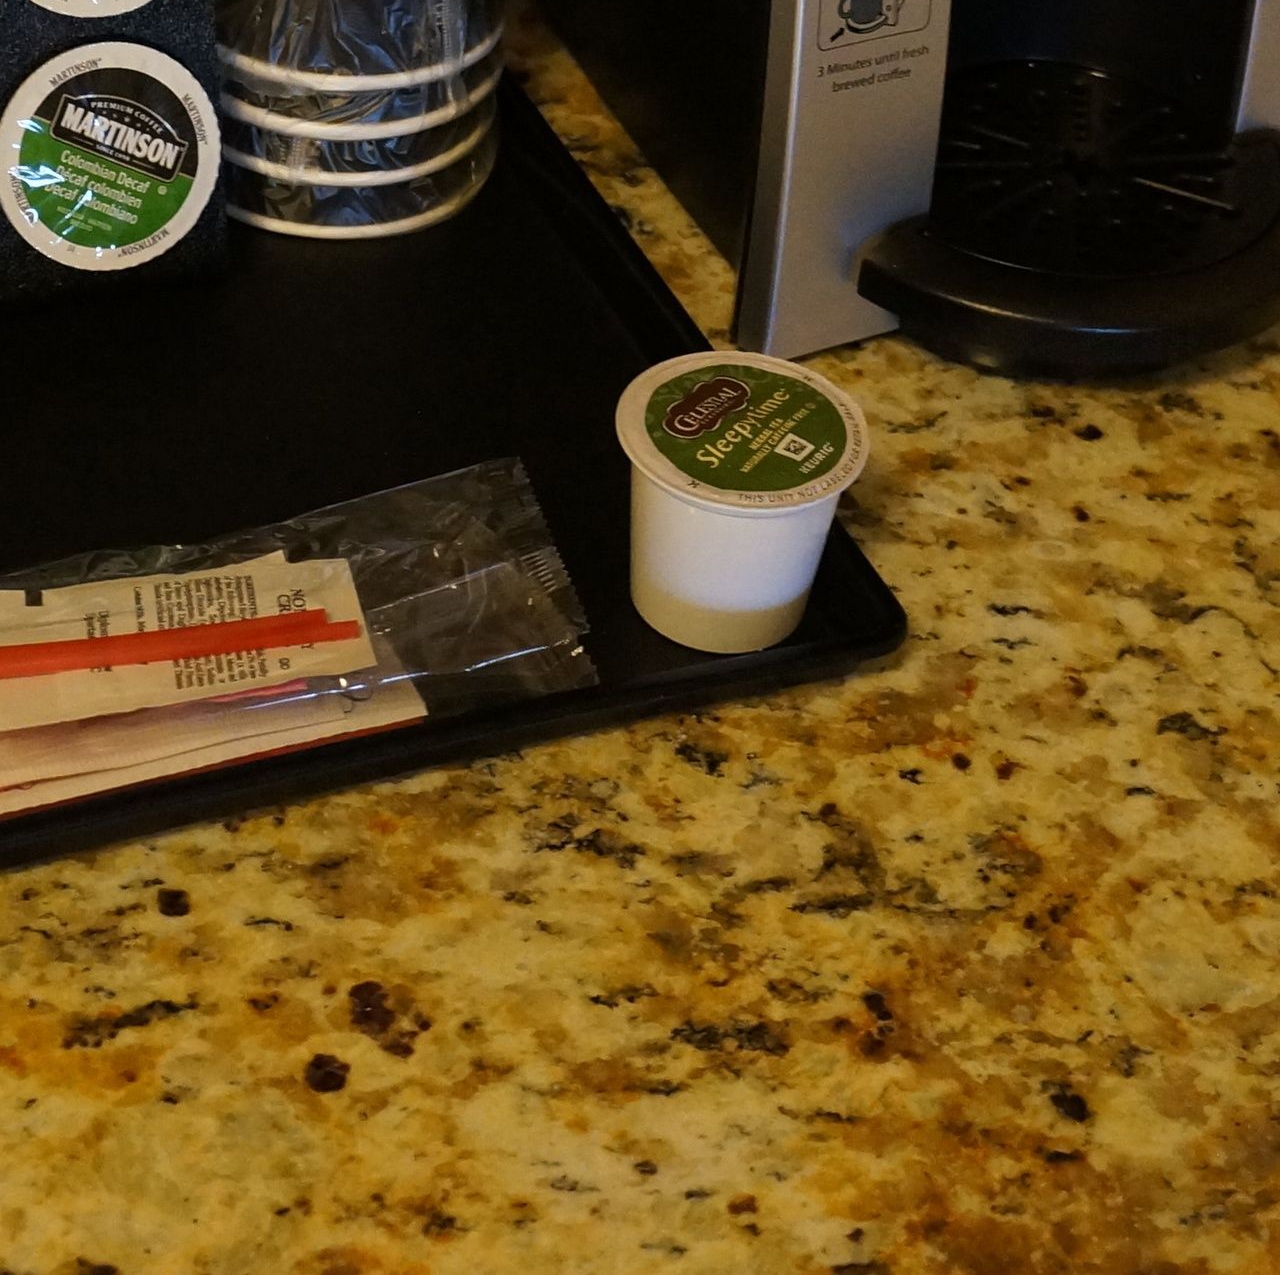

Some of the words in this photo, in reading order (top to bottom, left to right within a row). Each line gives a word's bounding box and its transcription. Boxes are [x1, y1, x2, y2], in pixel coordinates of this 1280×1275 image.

[49, 59, 101, 87] MARTINSON
[817, 66, 825, 78] 3
[826, 57, 874, 75] Minutes
[875, 50, 902, 66] until
[903, 46, 930, 60] fresh
[832, 74, 875, 93] brewed
[877, 67, 912, 84] coffee
[90, 101, 134, 115] PREMIUM
[134, 111, 165, 135] COFFEE
[60, 103, 180, 170] MARTINSON
[60, 149, 117, 182] Colombian
[116, 171, 151, 194] Decaf
[77, 192, 138, 225] clombiano
[87, 178, 143, 210] colombien
[674, 386, 739, 431] CELESTIAL
[695, 390, 791, 469] Sleepytime
[798, 443, 835, 475] KEURIG
